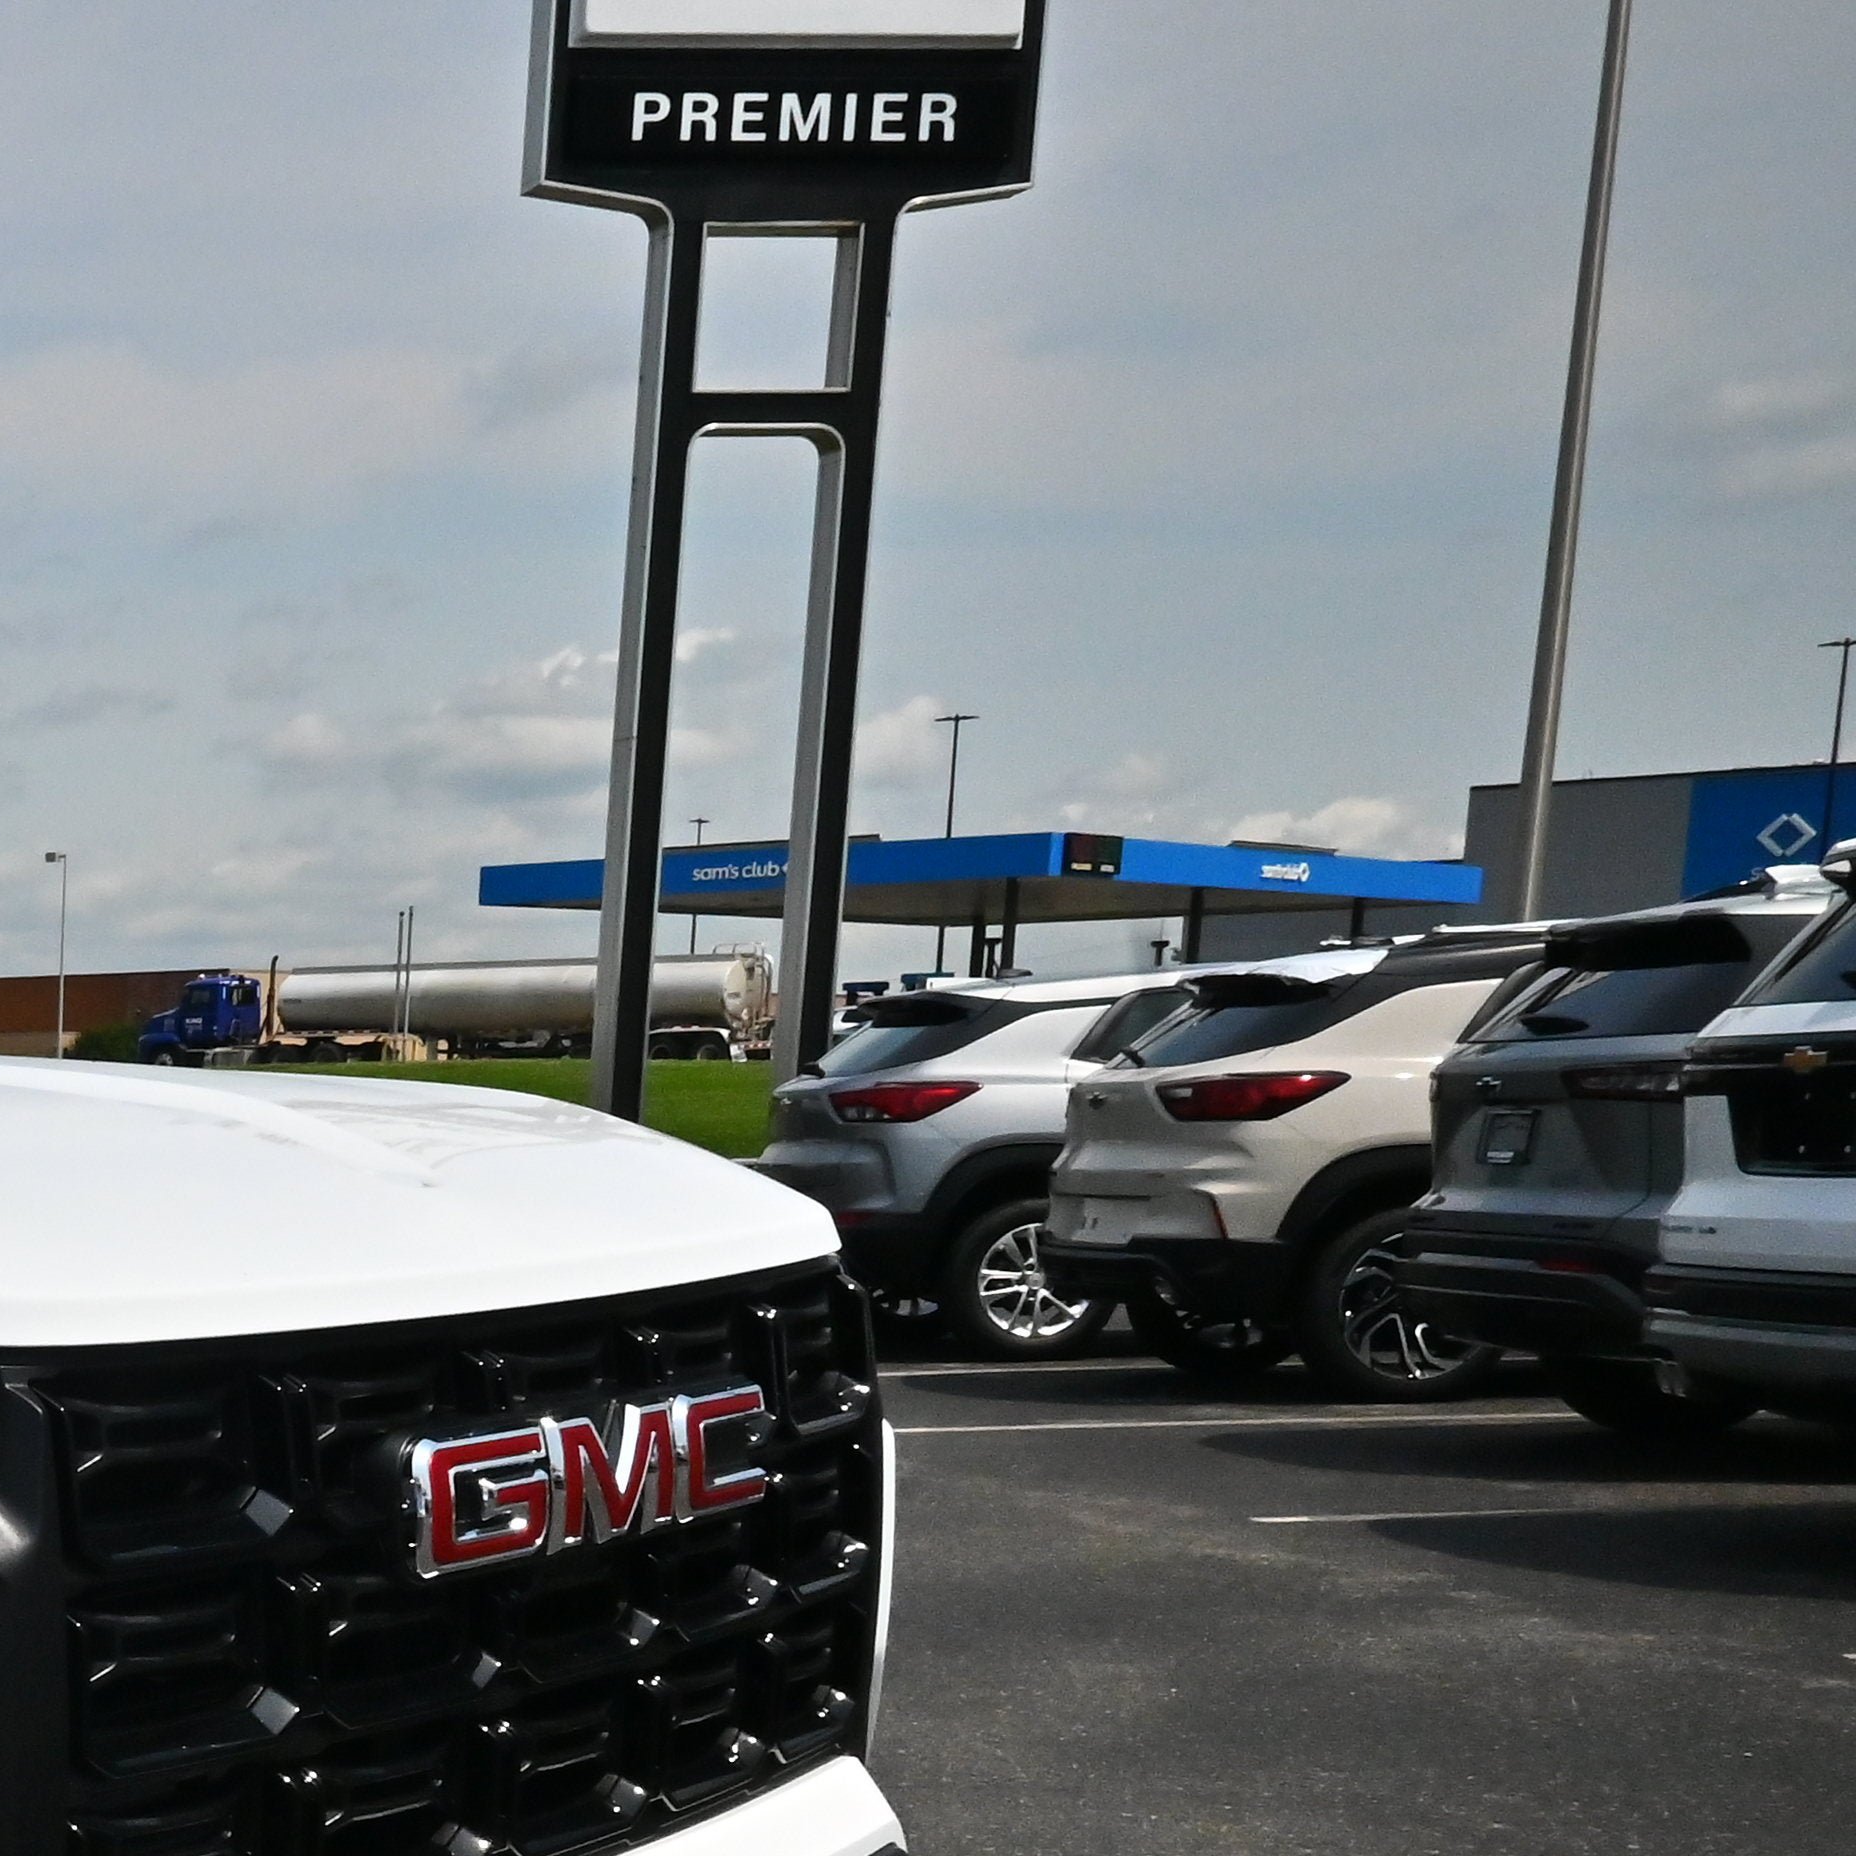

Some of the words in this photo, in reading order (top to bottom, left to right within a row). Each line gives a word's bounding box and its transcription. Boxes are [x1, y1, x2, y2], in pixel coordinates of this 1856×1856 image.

[630, 92, 958, 142] PREMIER
[692, 864, 738, 881] sam's
[742, 861, 779, 879] club
[411, 1384, 767, 1579] GMC
